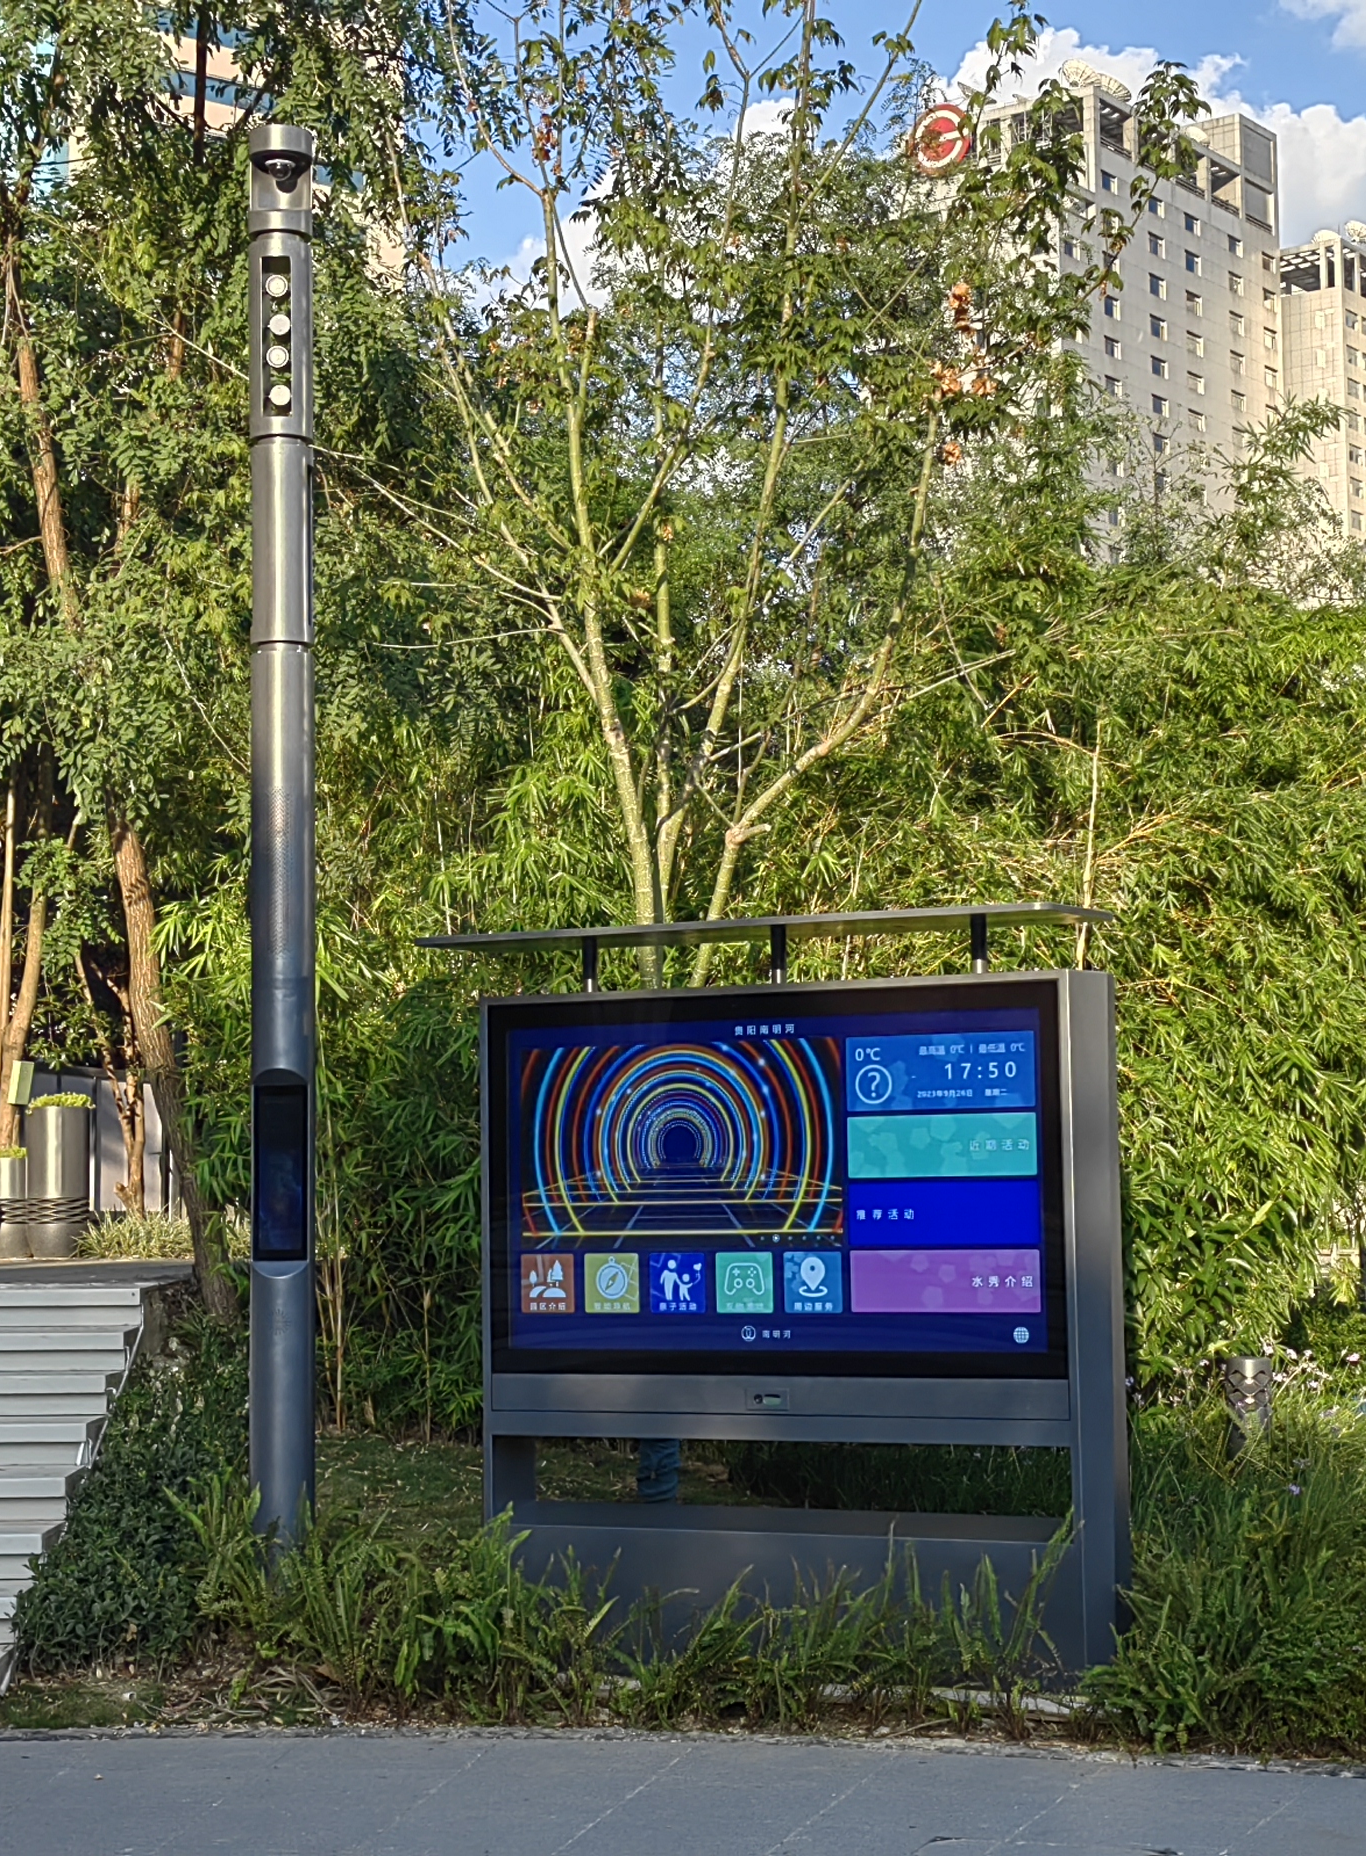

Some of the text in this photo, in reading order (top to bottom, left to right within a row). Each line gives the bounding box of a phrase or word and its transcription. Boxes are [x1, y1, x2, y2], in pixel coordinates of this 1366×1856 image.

[734, 1023, 795, 1036] 贵阳南明河
[944, 1061, 1017, 1080] 17:50
[969, 1139, 1030, 1151] 近期活动
[856, 1209, 915, 1220] 推荐活动
[971, 1275, 1033, 1288] 水秀介绍
